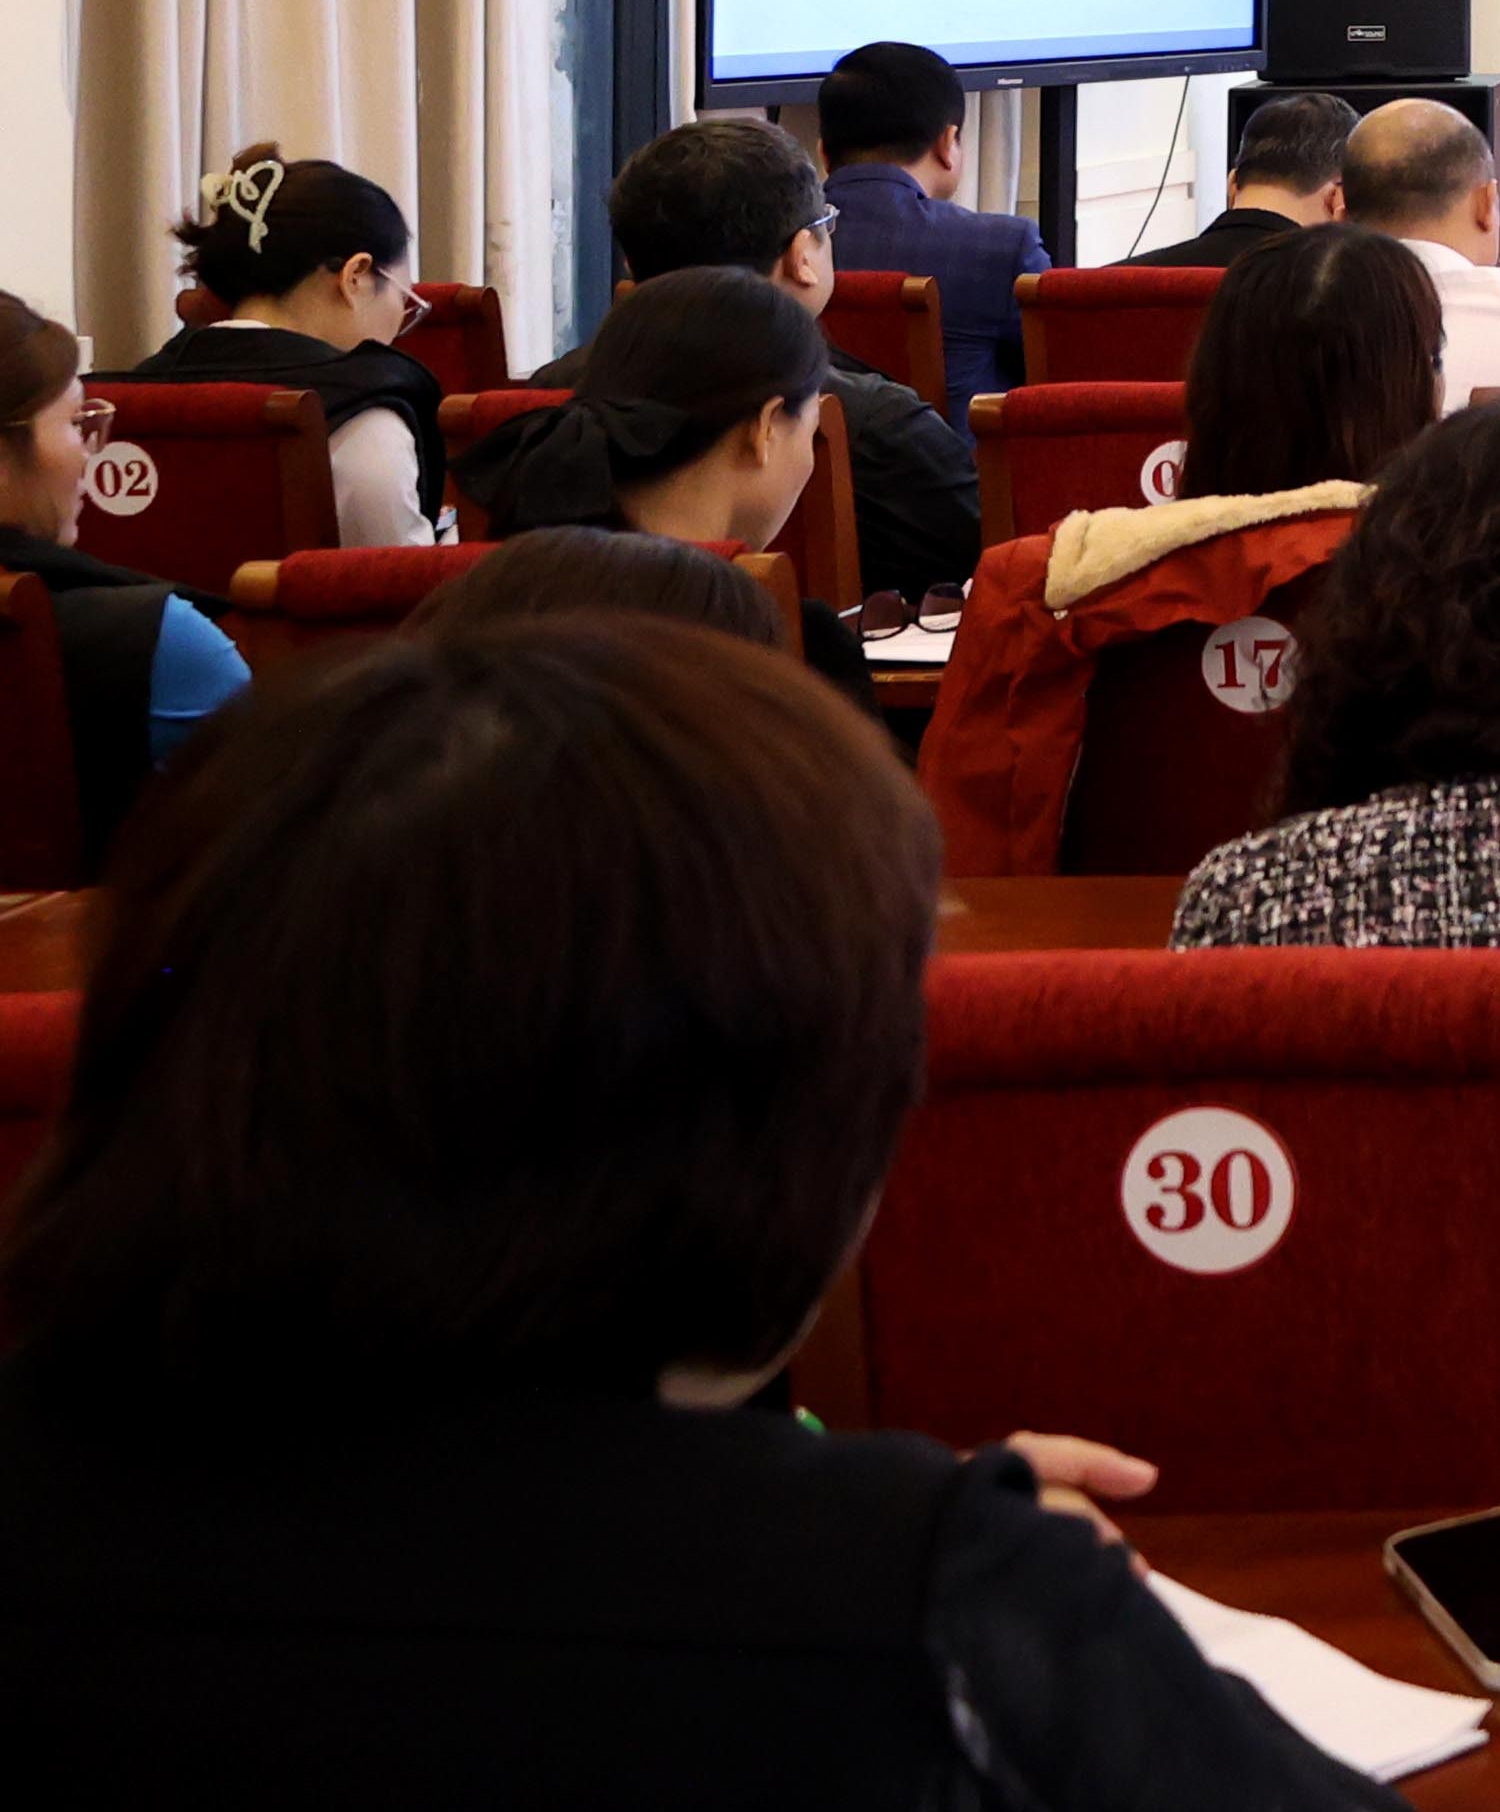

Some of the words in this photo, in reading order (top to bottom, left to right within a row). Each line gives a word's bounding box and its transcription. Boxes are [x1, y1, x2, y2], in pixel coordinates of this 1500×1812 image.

[94, 459, 153, 498] 02
[1152, 459, 1179, 498] 0
[1215, 639, 1287, 690] 17
[1145, 1148, 1272, 1234] 30
